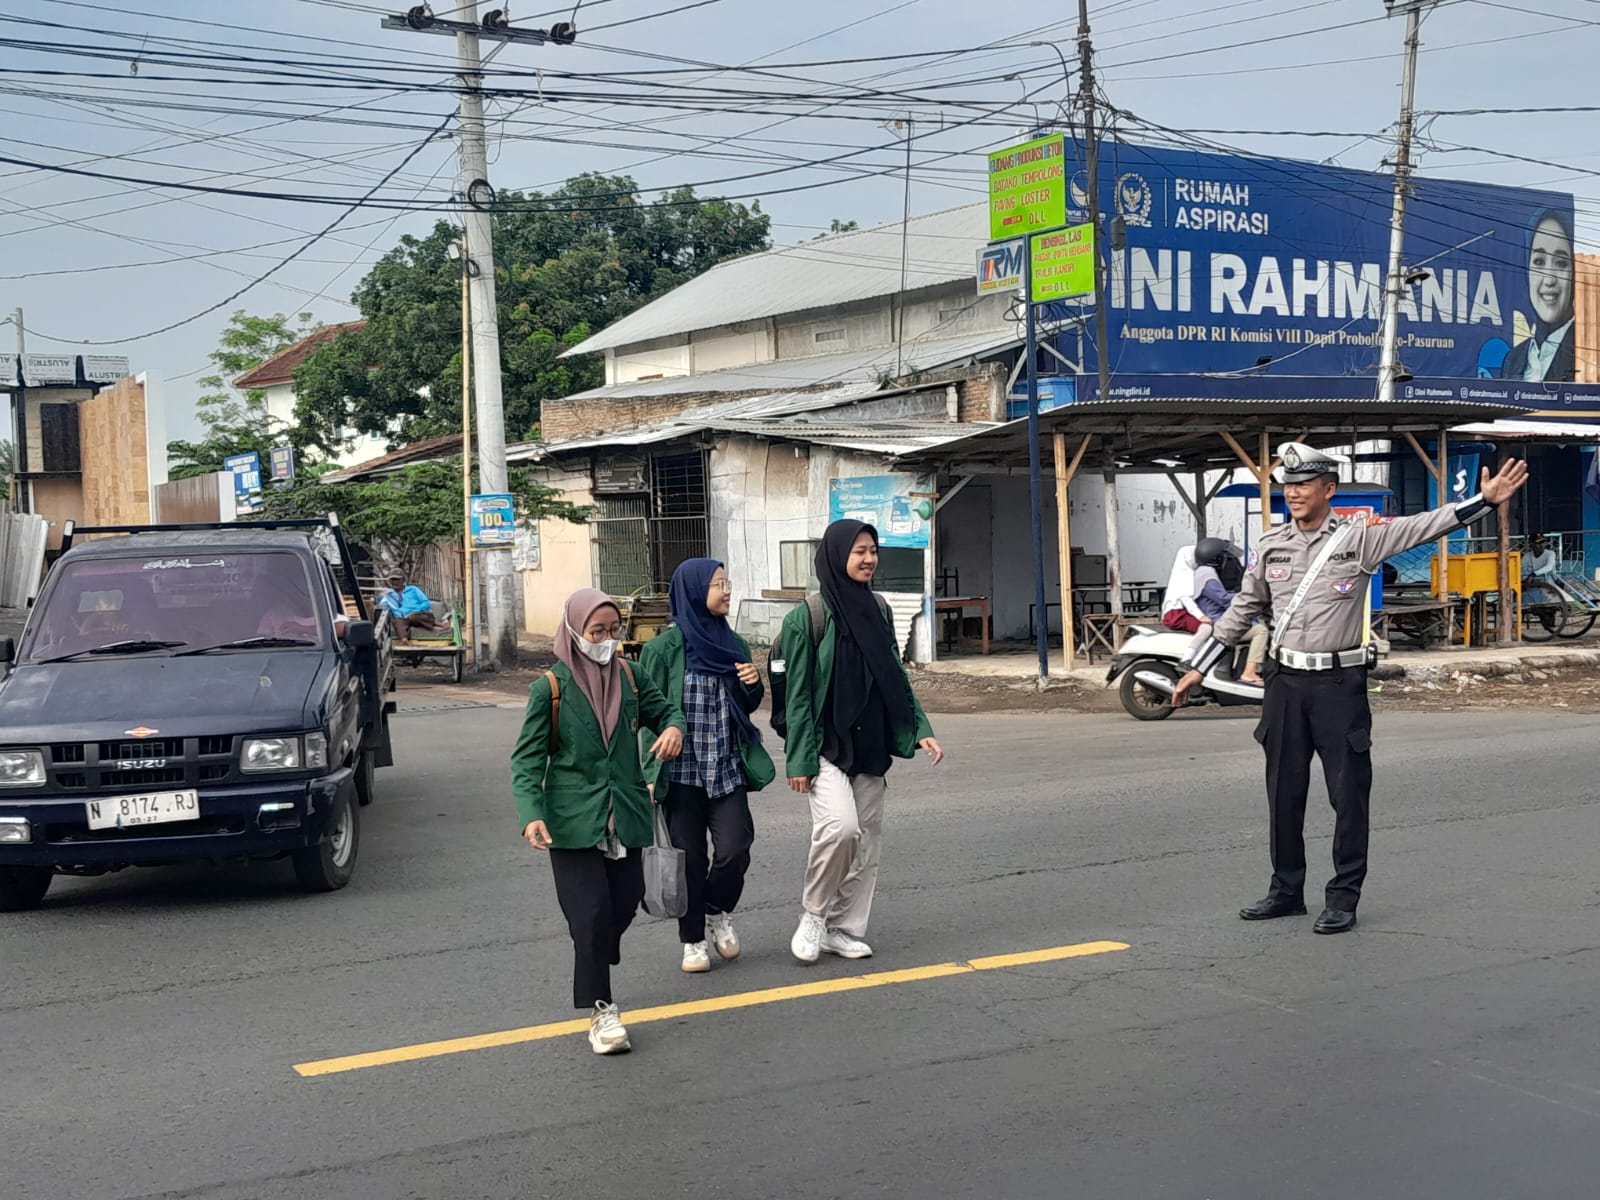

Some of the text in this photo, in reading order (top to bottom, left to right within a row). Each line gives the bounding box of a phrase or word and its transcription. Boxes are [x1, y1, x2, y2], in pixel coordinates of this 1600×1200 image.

[1021, 164, 1063, 185] TEMPOLONG
[1021, 188, 1050, 206] LOSTER
[1175, 179, 1249, 206] RUMAH
[1175, 206, 1269, 235] ASPIRASI
[1100, 246, 1504, 326] INI RAHMANIA
[1120, 324, 1455, 348] Anggota DPR RI Komisi VIII Dapil Probolino-Pasuruan
[1095, 387, 1151, 397] ww.ningdini.id
[1328, 551, 1357, 562] POLRI
[117, 759, 167, 770] ISUZU
[90, 792, 196, 820] N 8174 RJ
